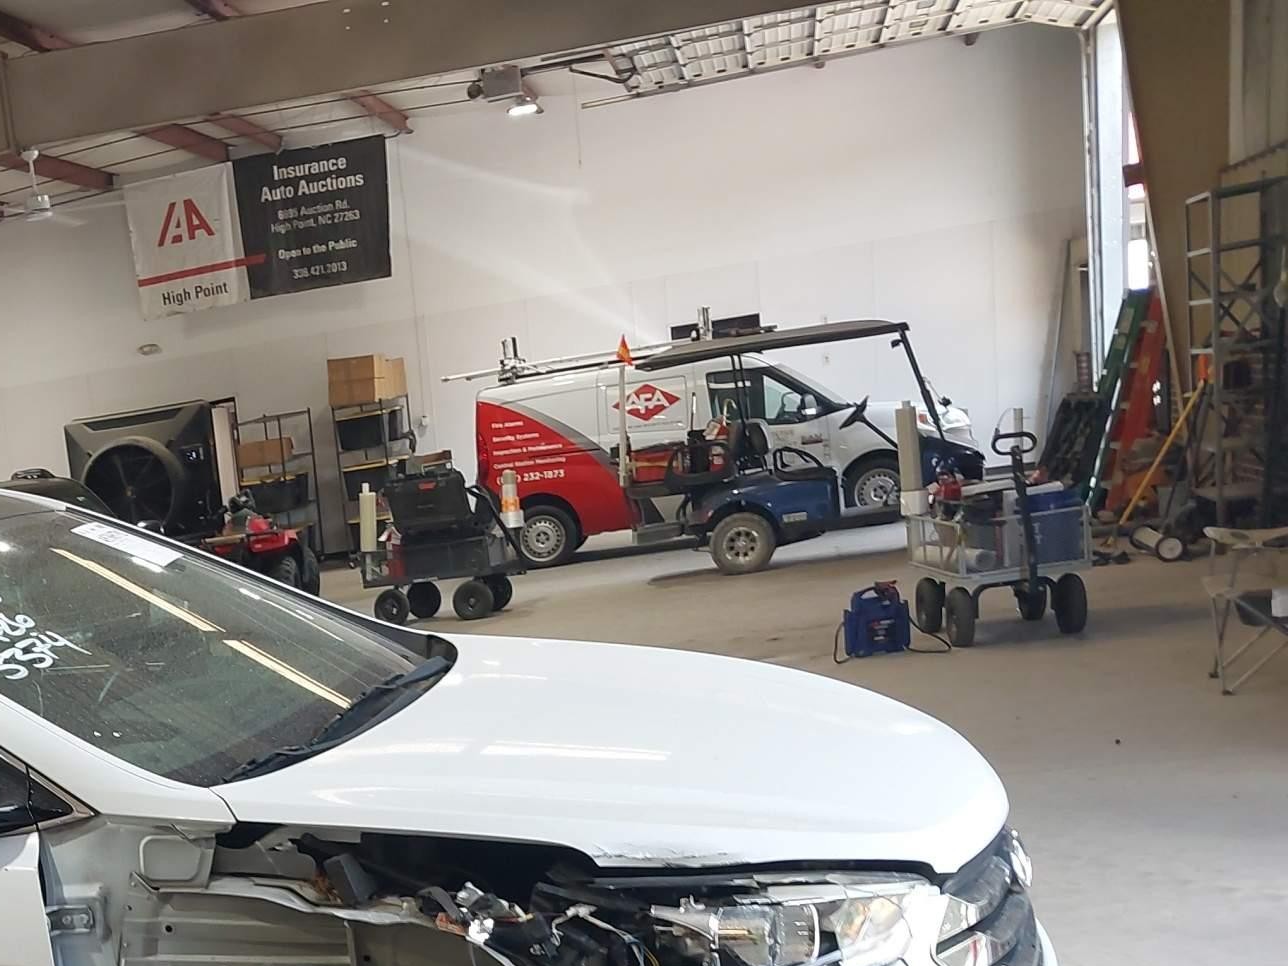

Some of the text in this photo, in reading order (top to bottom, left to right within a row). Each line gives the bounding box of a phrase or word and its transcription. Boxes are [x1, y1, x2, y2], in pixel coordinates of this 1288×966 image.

[273, 157, 347, 180] Insurance
[261, 173, 364, 202] Auto Auctions
[318, 213, 332, 225] NC
[278, 238, 358, 260] Open to the Public
[162, 282, 229, 306] High Point
[624, 389, 670, 414] AFA
